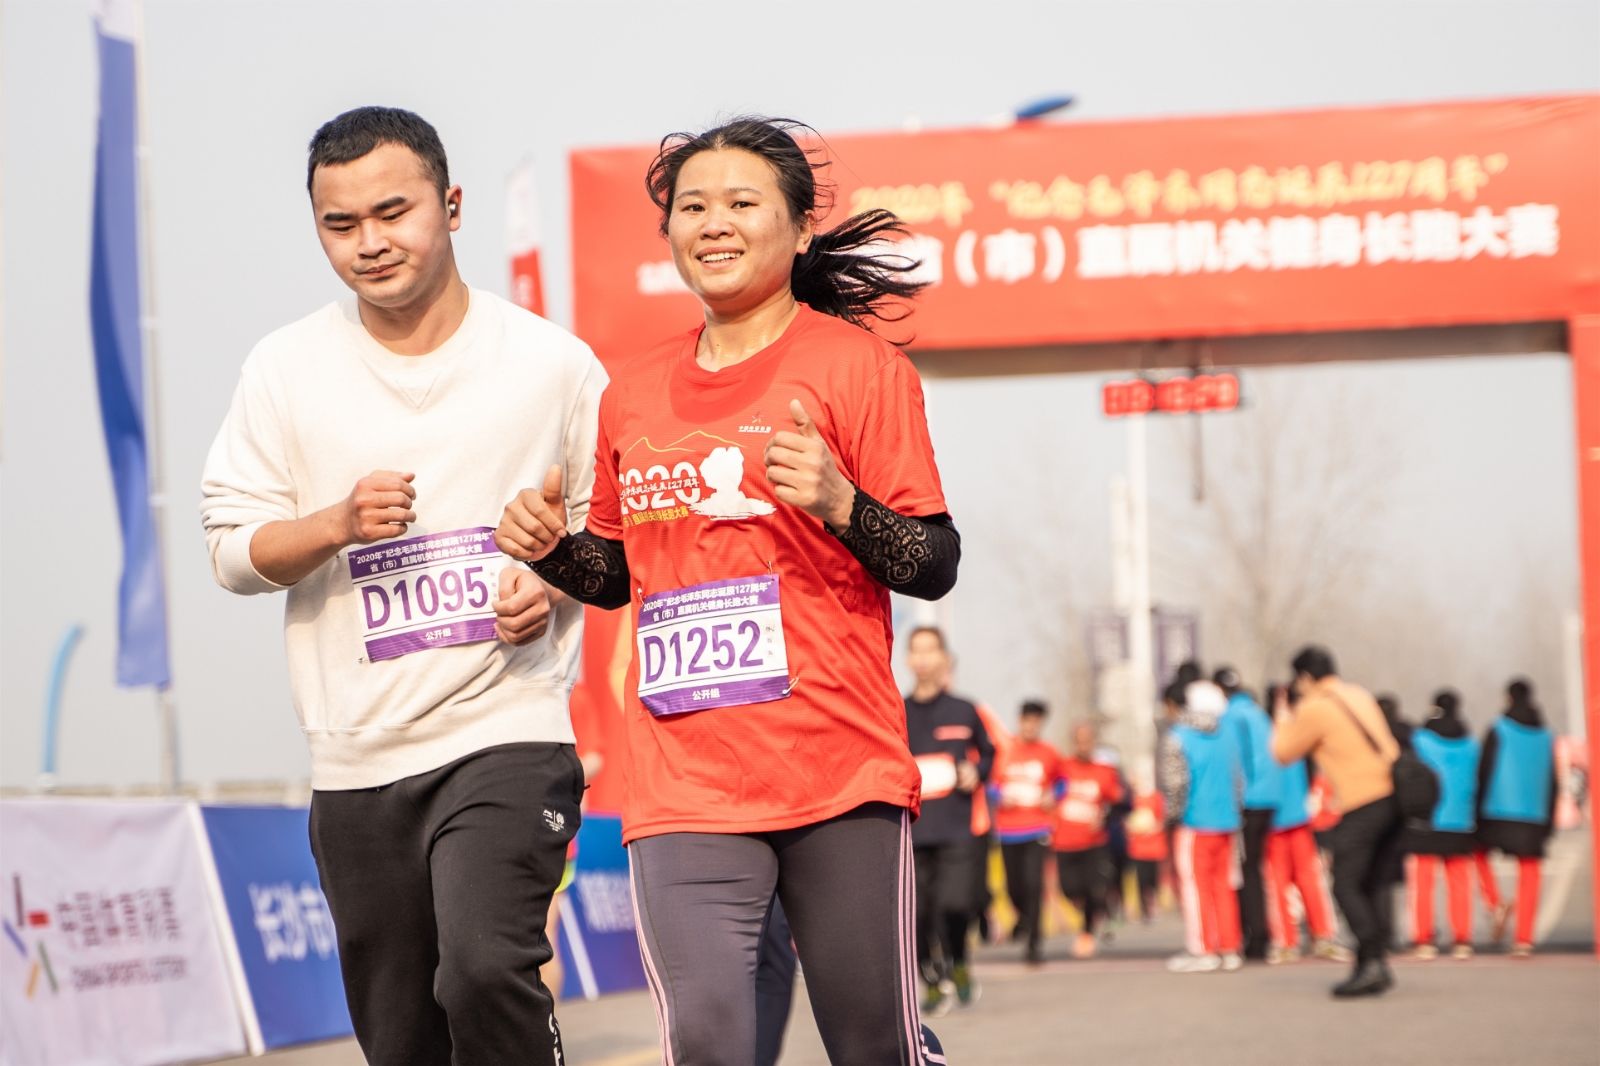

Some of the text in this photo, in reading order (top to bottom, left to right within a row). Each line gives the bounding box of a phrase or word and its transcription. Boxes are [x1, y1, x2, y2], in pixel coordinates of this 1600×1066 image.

[361, 566, 489, 630] D1095
[425, 627, 452, 641] 公开组
[643, 619, 764, 684] D1252
[692, 688, 721, 701] 公开组
